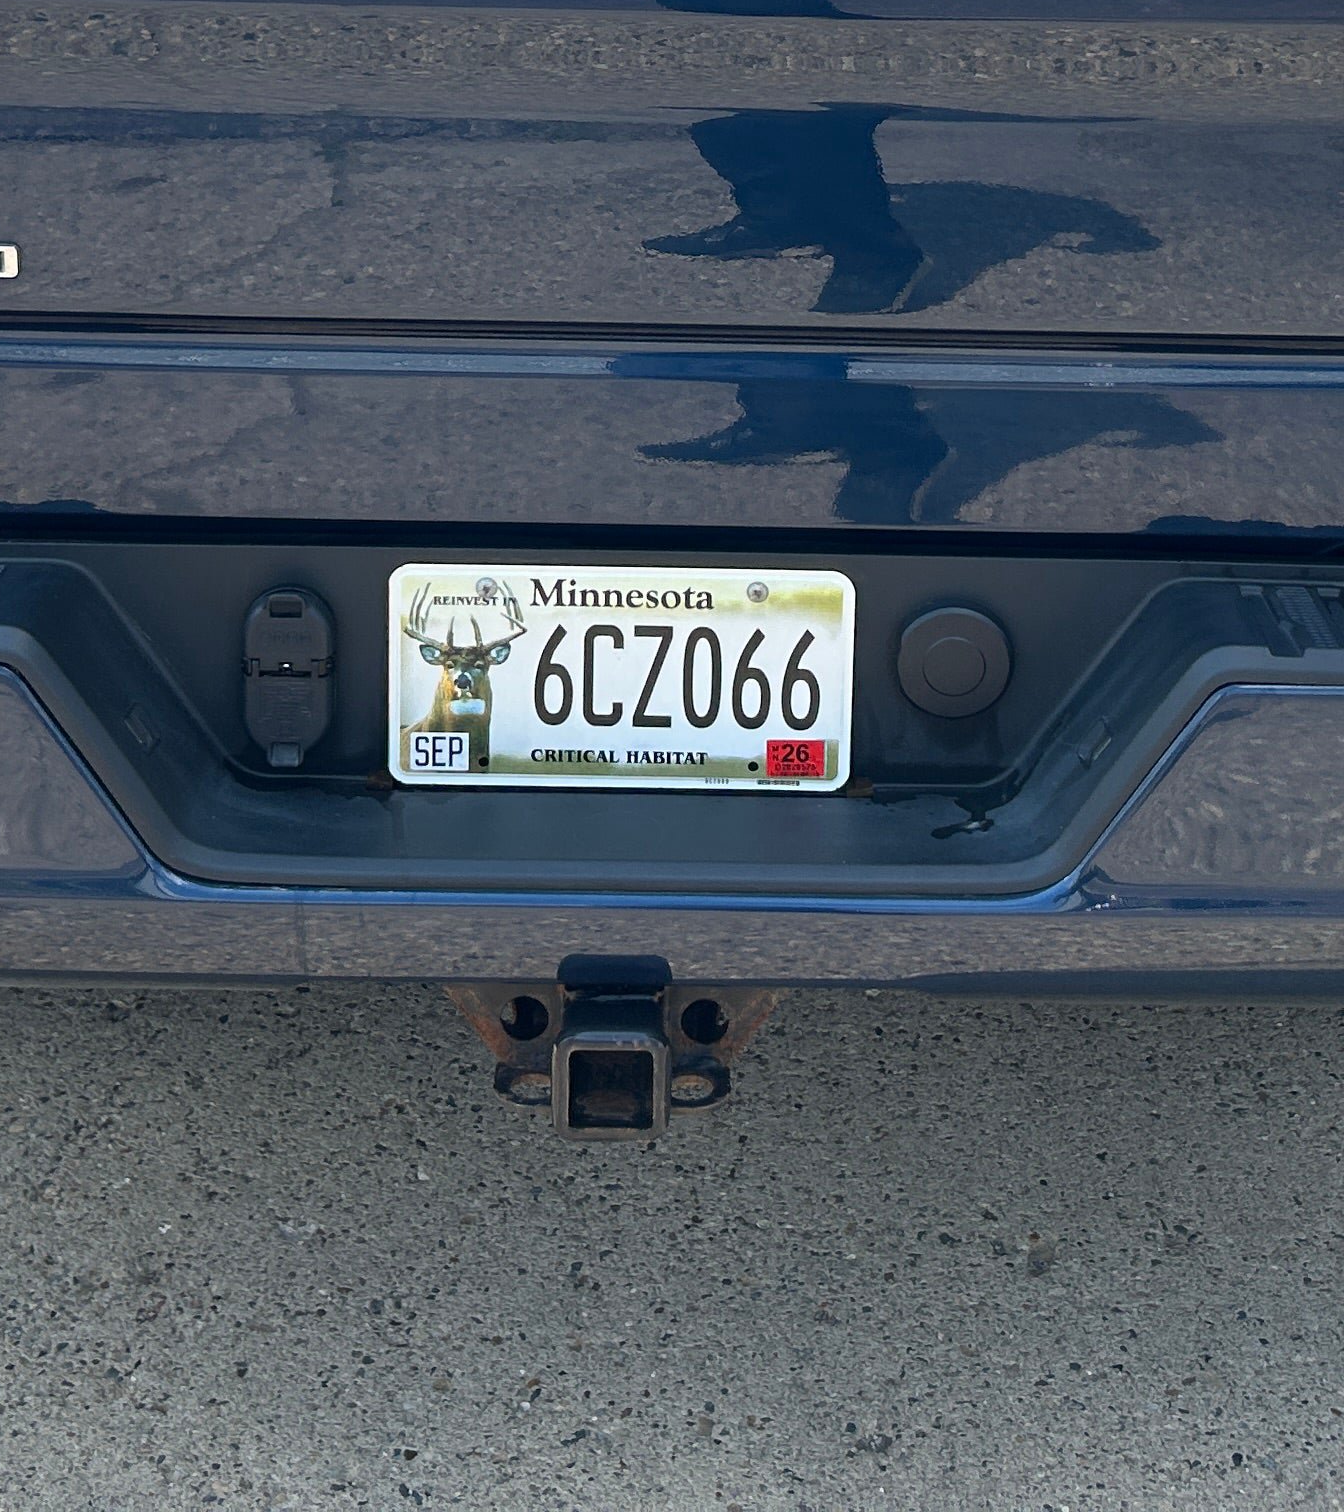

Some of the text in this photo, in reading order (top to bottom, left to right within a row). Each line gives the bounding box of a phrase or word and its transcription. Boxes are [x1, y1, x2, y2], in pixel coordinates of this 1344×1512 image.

[433, 595, 500, 606] REINVEST
[530, 578, 715, 611] Minnesota
[534, 623, 822, 731] 6CZ066
[414, 735, 464, 769] SEP
[531, 749, 709, 767] CRITICAL HABITAT
[781, 743, 810, 763] 26
